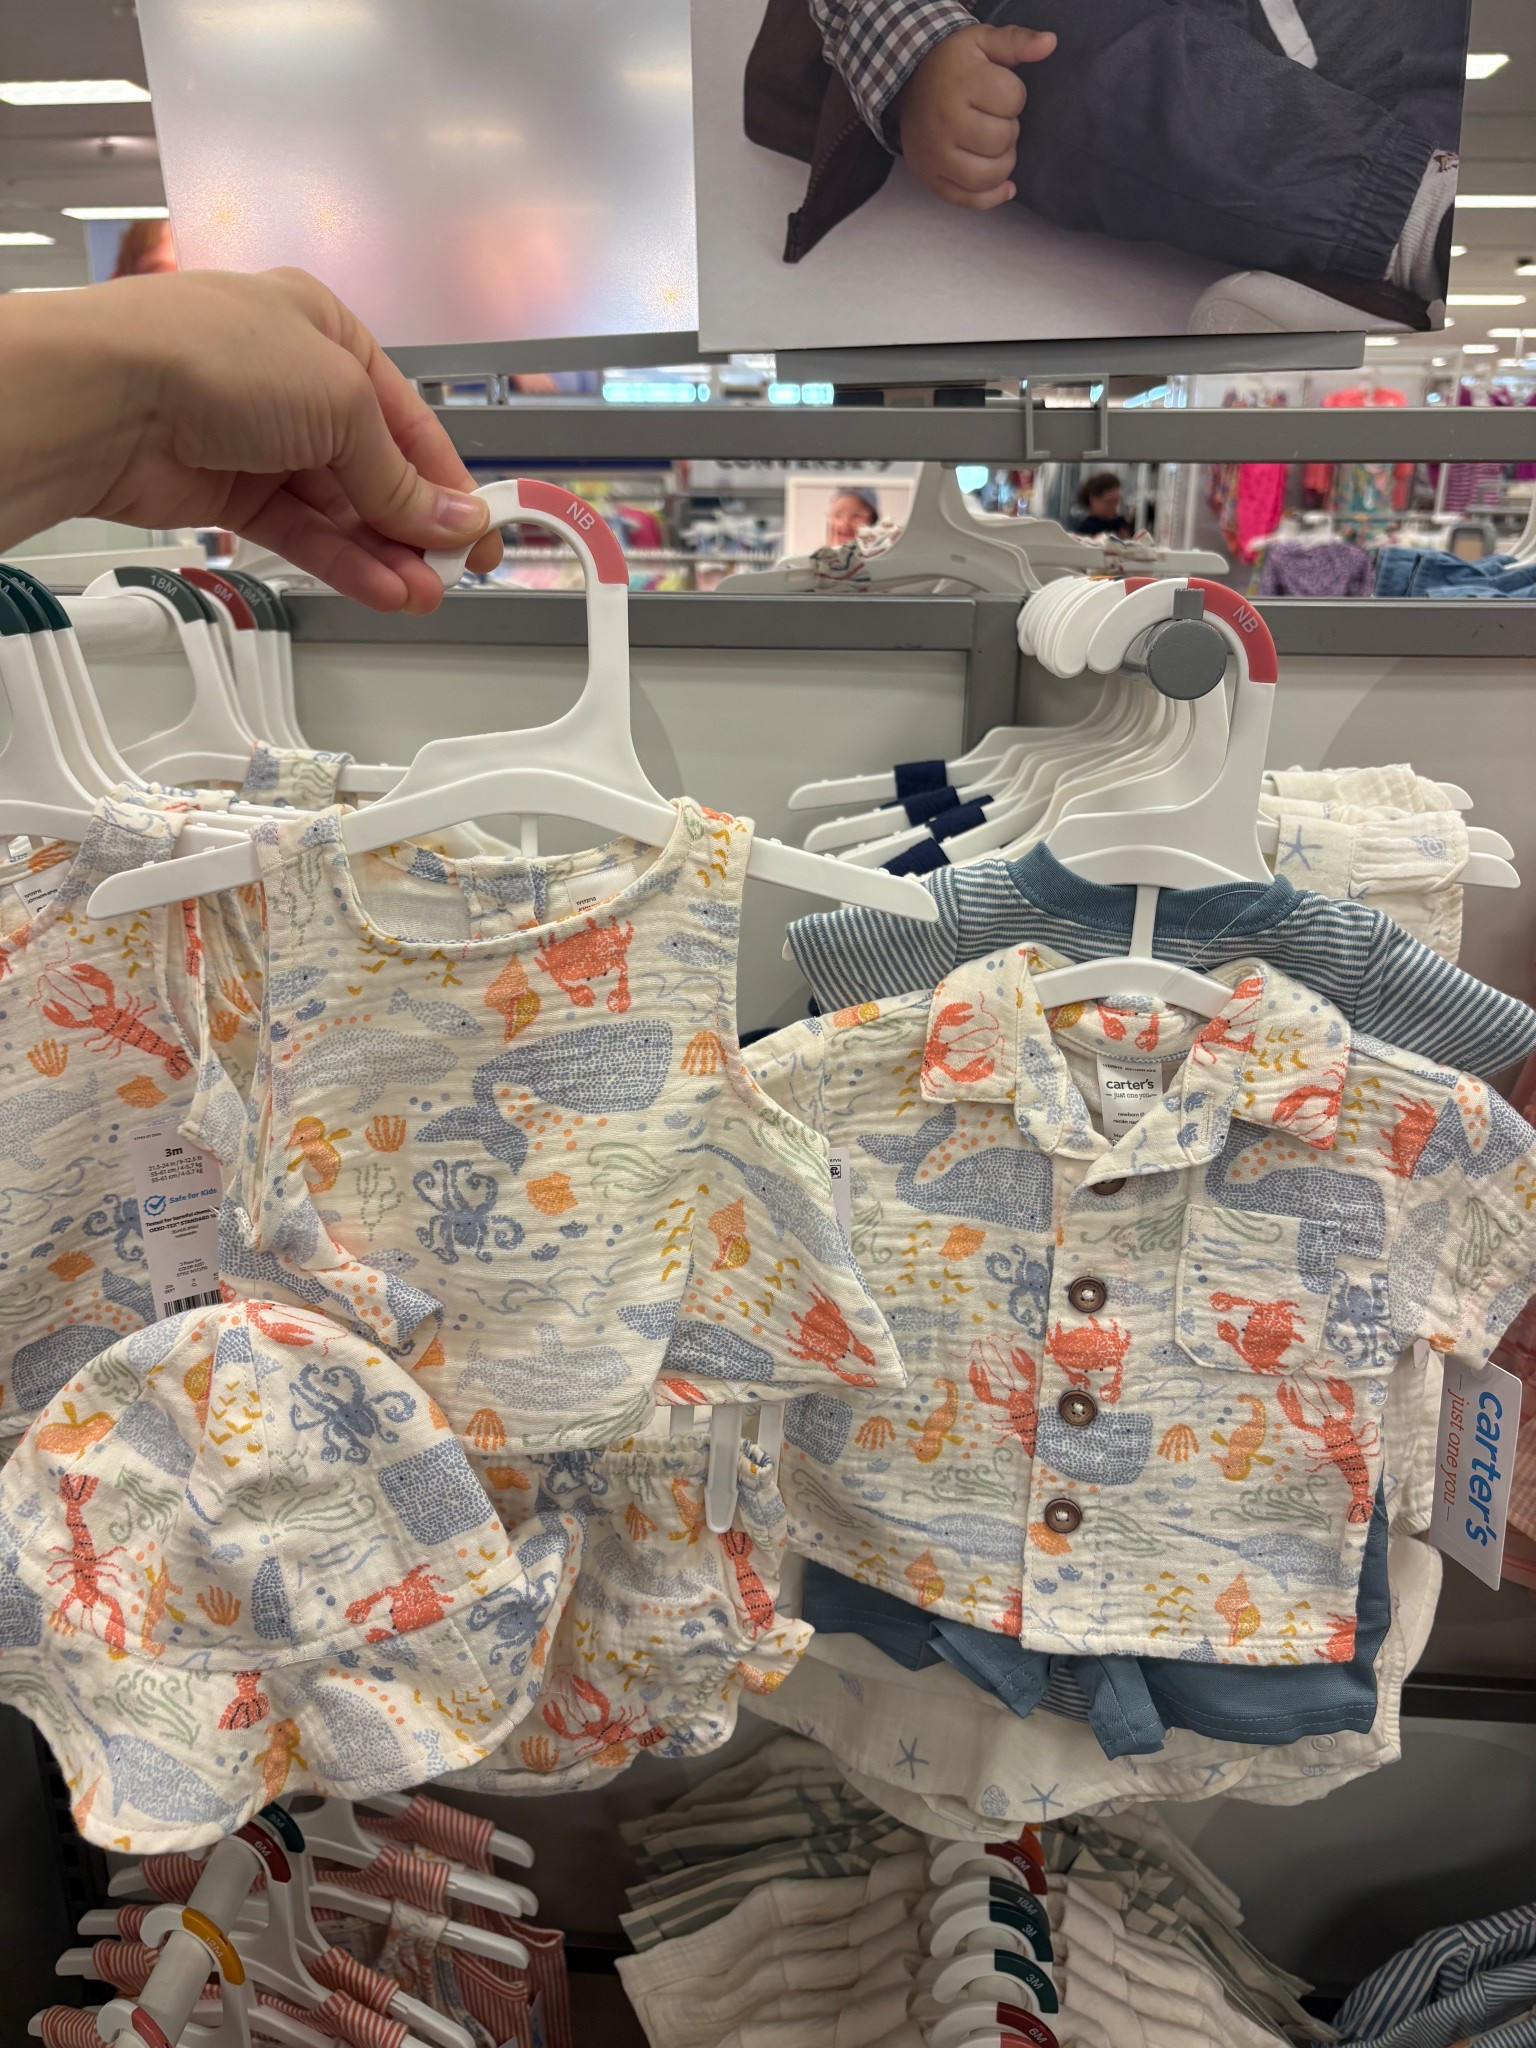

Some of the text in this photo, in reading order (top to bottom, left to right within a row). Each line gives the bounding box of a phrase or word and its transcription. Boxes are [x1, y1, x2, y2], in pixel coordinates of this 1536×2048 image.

[566, 501, 595, 531] NB
[150, 574, 178, 597] 18M
[213, 584, 233, 603] 6M
[1232, 604, 1259, 633] NB
[1106, 1079, 1154, 1090] carter's
[1113, 1091, 1126, 1100] just
[165, 1147, 183, 1157] 3m
[169, 1187, 217, 1203] Safe for Kids
[180, 1215, 209, 1226] STANDARD
[1440, 1388, 1470, 1506] just one you
[1465, 1391, 1503, 1547] carter's
[254, 1840, 271, 1857] 6M
[1012, 1855, 1031, 1871] 6M
[1016, 1896, 1038, 1916] 18M
[1021, 1924, 1038, 1938] 3M
[205, 1935, 224, 1958] 12M
[1025, 1973, 1045, 1990] 3M
[1028, 2027, 1048, 2044] 6M
